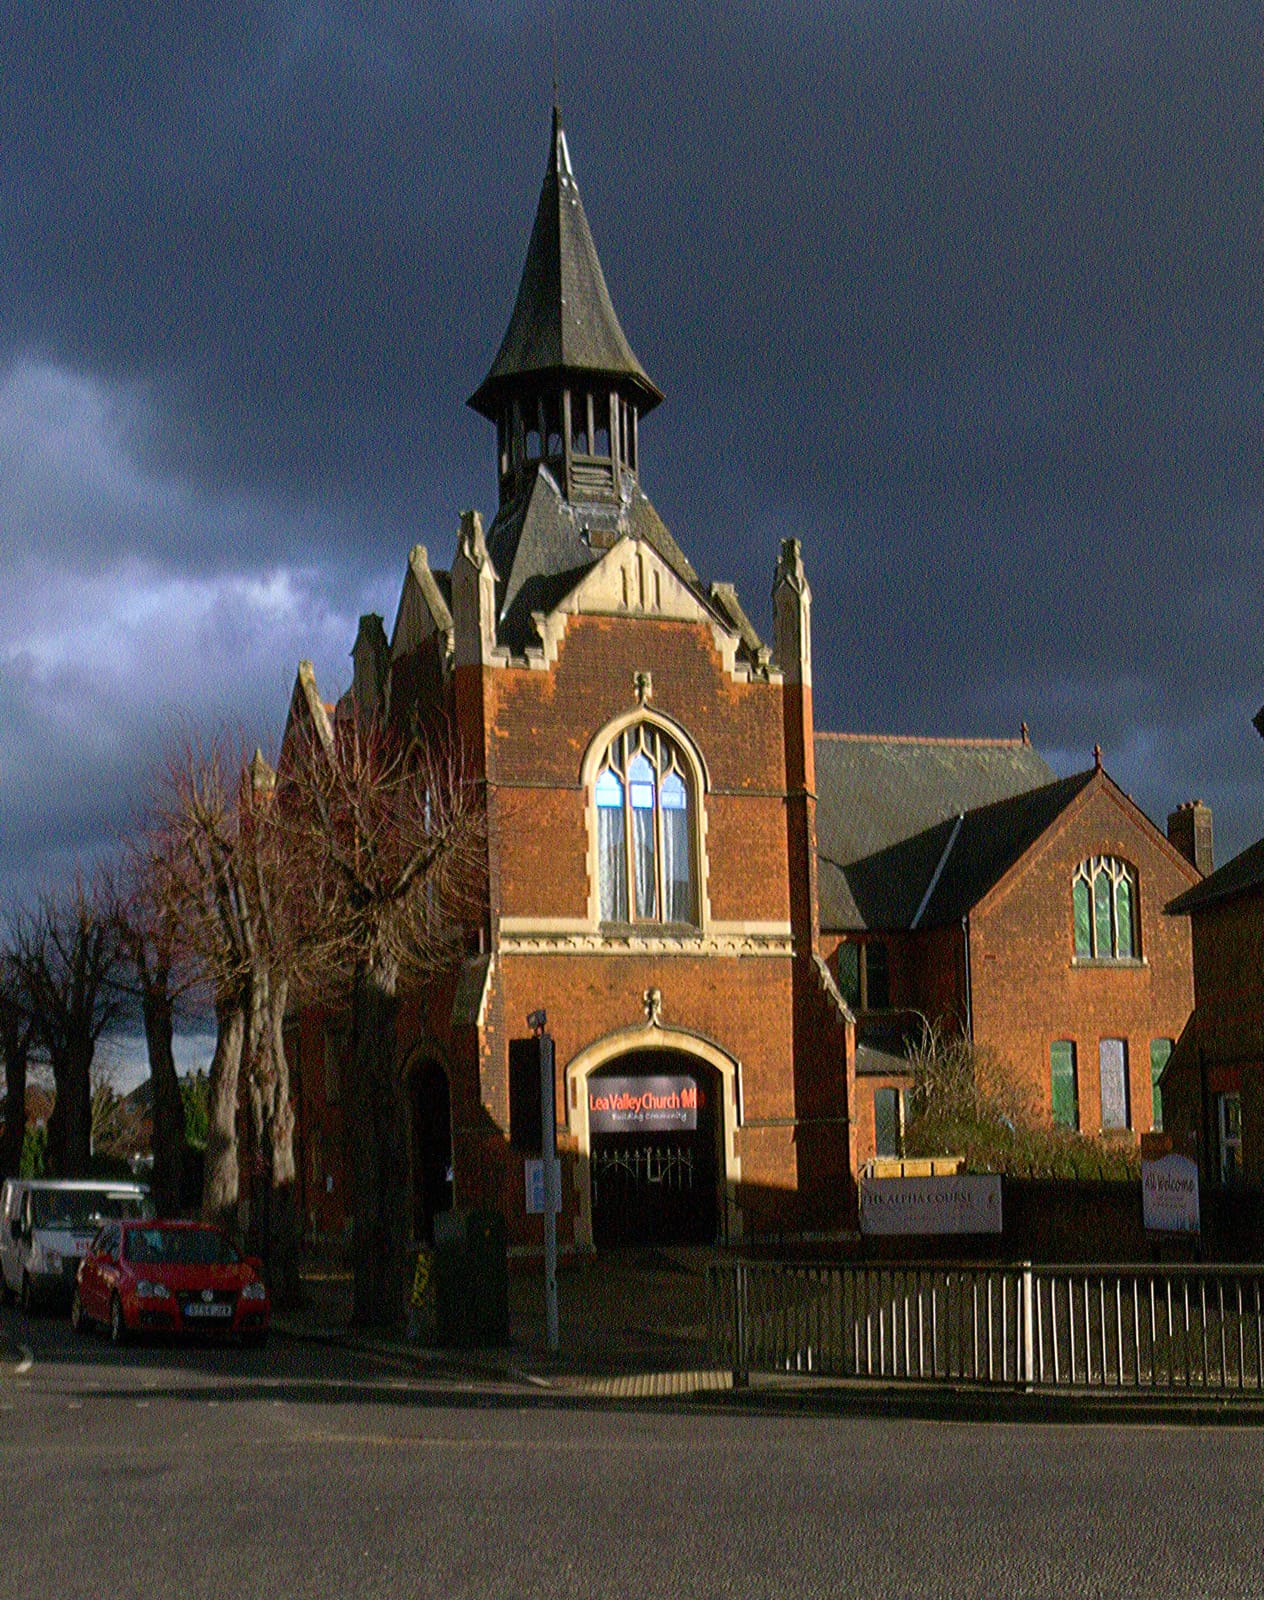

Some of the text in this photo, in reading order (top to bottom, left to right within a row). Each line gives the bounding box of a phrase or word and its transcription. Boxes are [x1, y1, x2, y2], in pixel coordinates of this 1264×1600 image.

[589, 1091, 680, 1113] Lea Valley Church
[887, 1193, 924, 1204] ALPHA
[926, 1192, 971, 1203] COURSE
